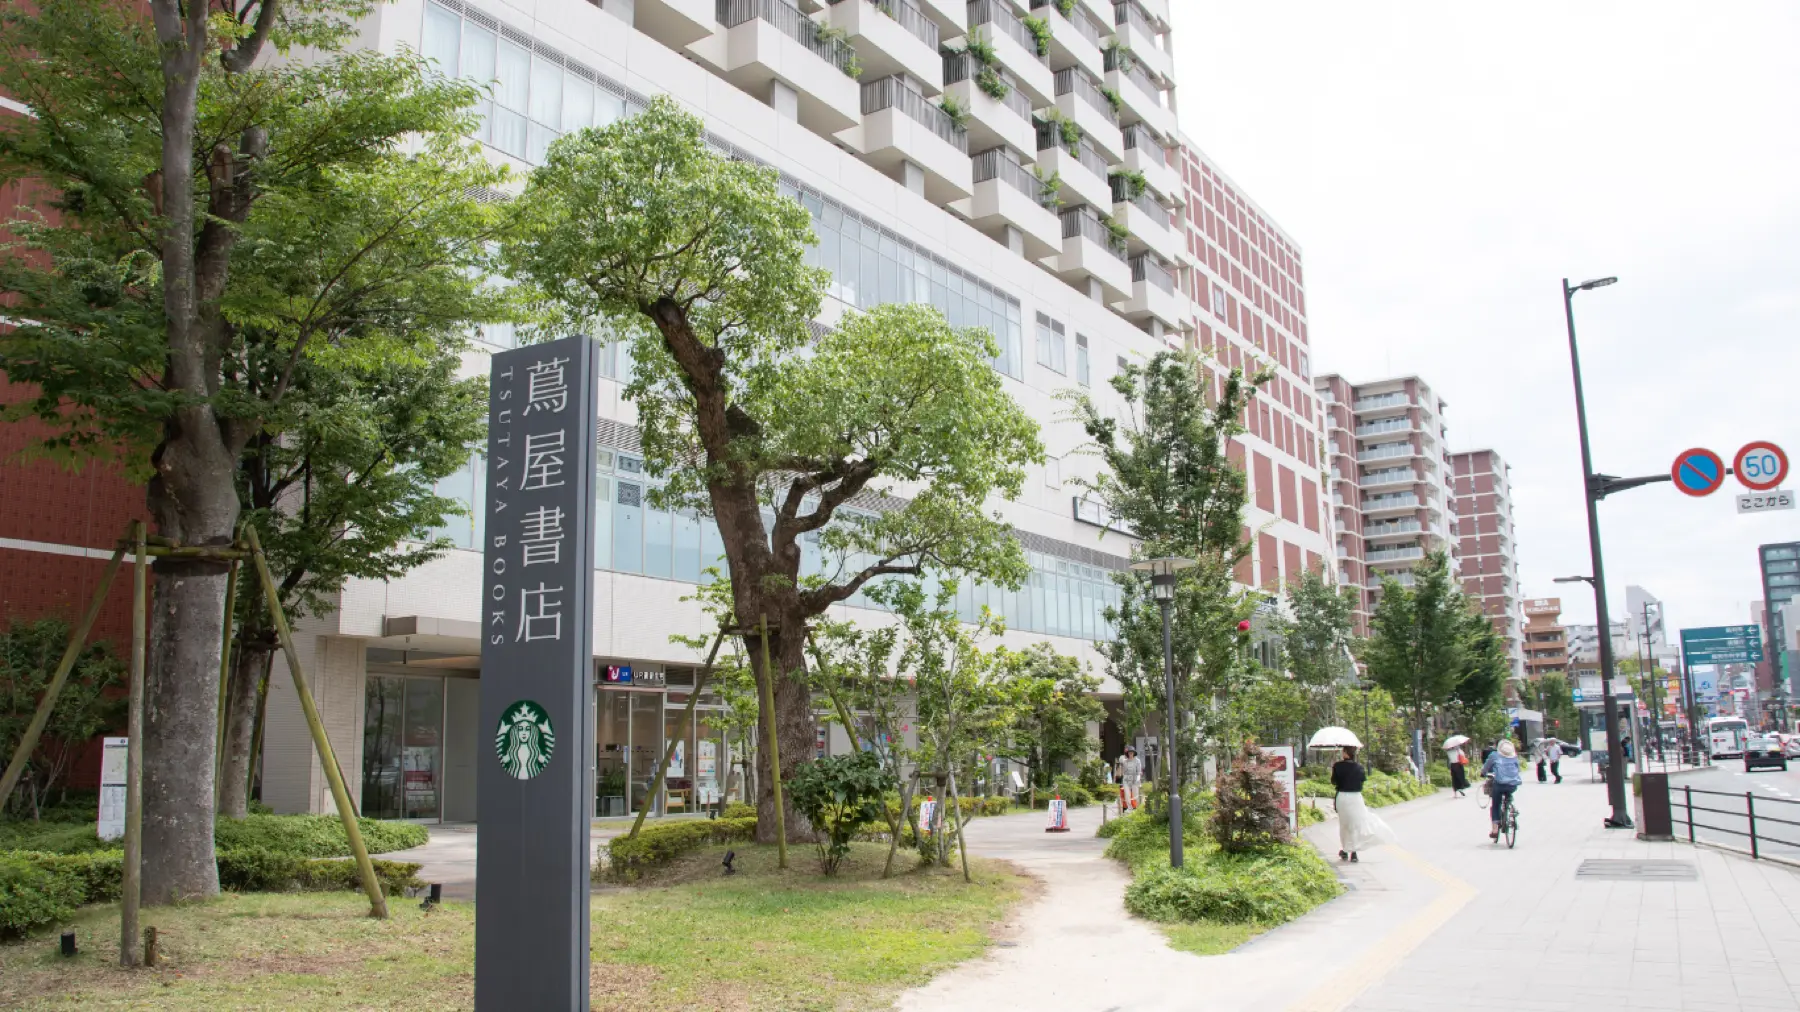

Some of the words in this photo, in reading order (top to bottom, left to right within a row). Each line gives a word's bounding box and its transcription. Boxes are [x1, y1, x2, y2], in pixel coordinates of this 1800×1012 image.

[495, 365, 514, 514] TSUTAYA
[1745, 454, 1777, 478] 50
[515, 356, 570, 643] 蔦屋書店
[1740, 493, 1790, 509] ここから
[490, 535, 507, 645] BOOKS
